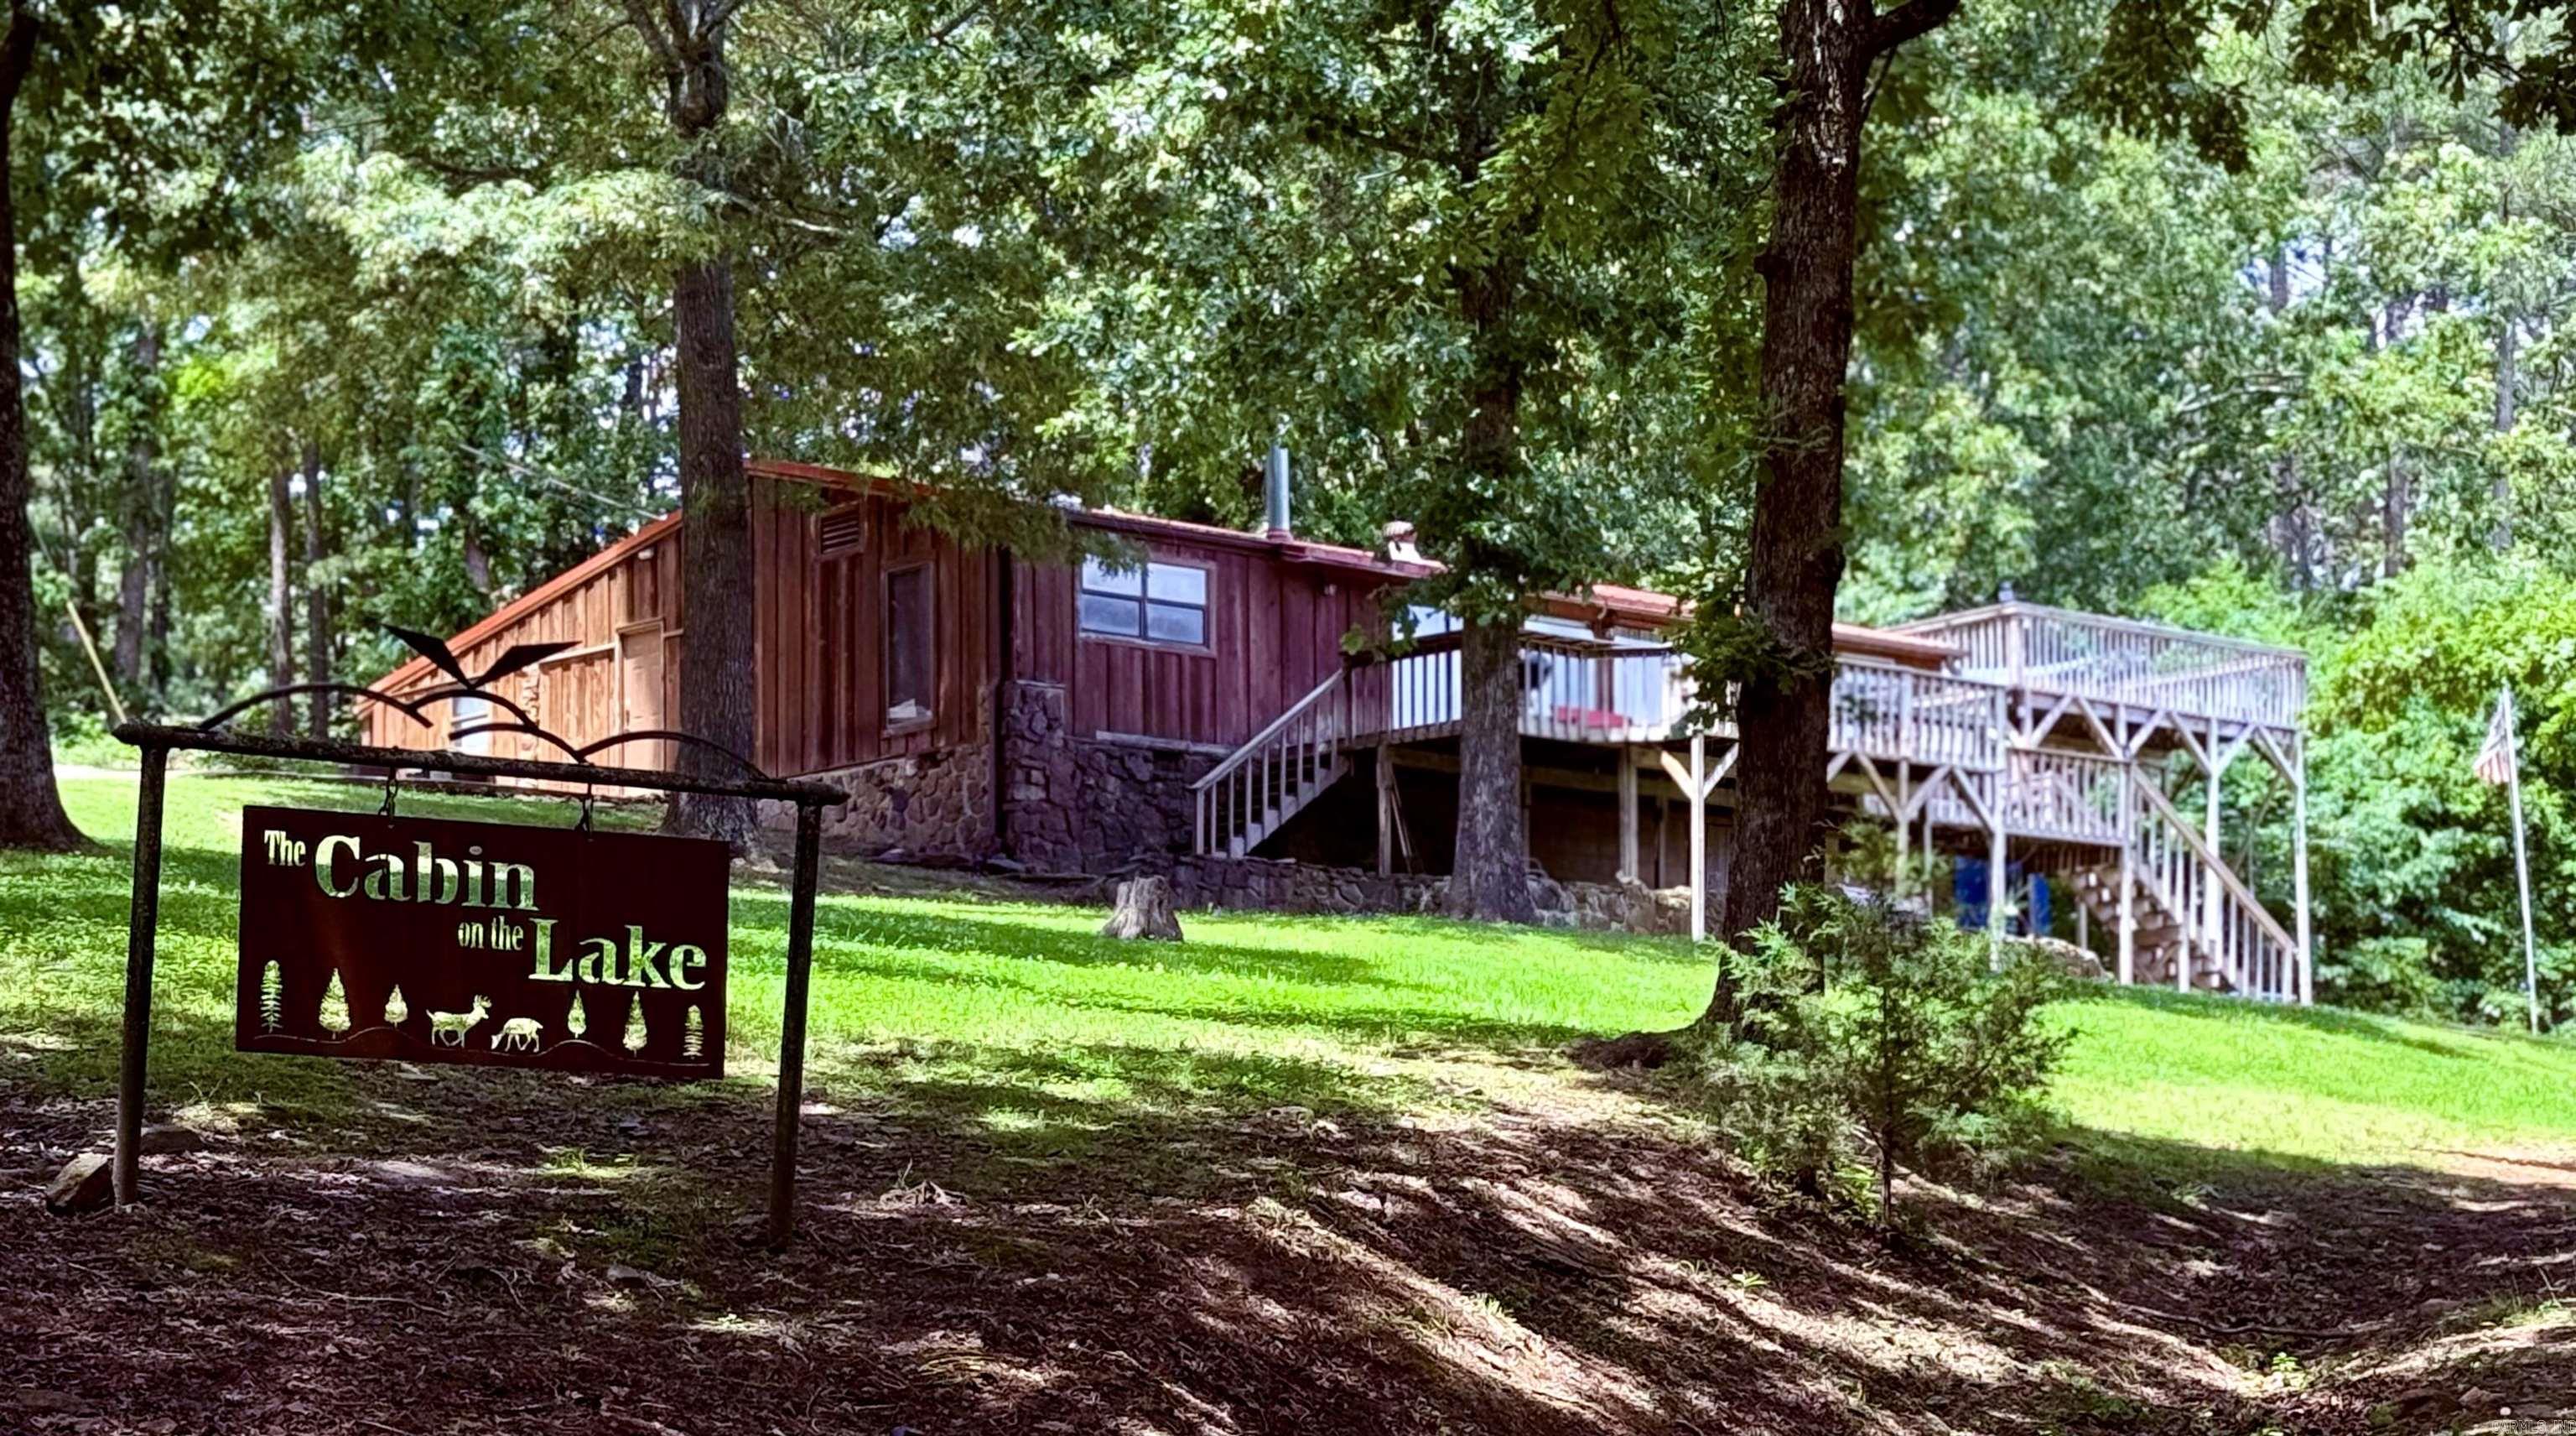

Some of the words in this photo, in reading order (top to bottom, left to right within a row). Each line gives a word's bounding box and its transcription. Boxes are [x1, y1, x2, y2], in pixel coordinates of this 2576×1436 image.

[263, 830, 306, 867] The
[315, 835, 540, 911] Cabin
[458, 922, 484, 950] on
[491, 915, 524, 951] the
[527, 918, 707, 991] Lake
